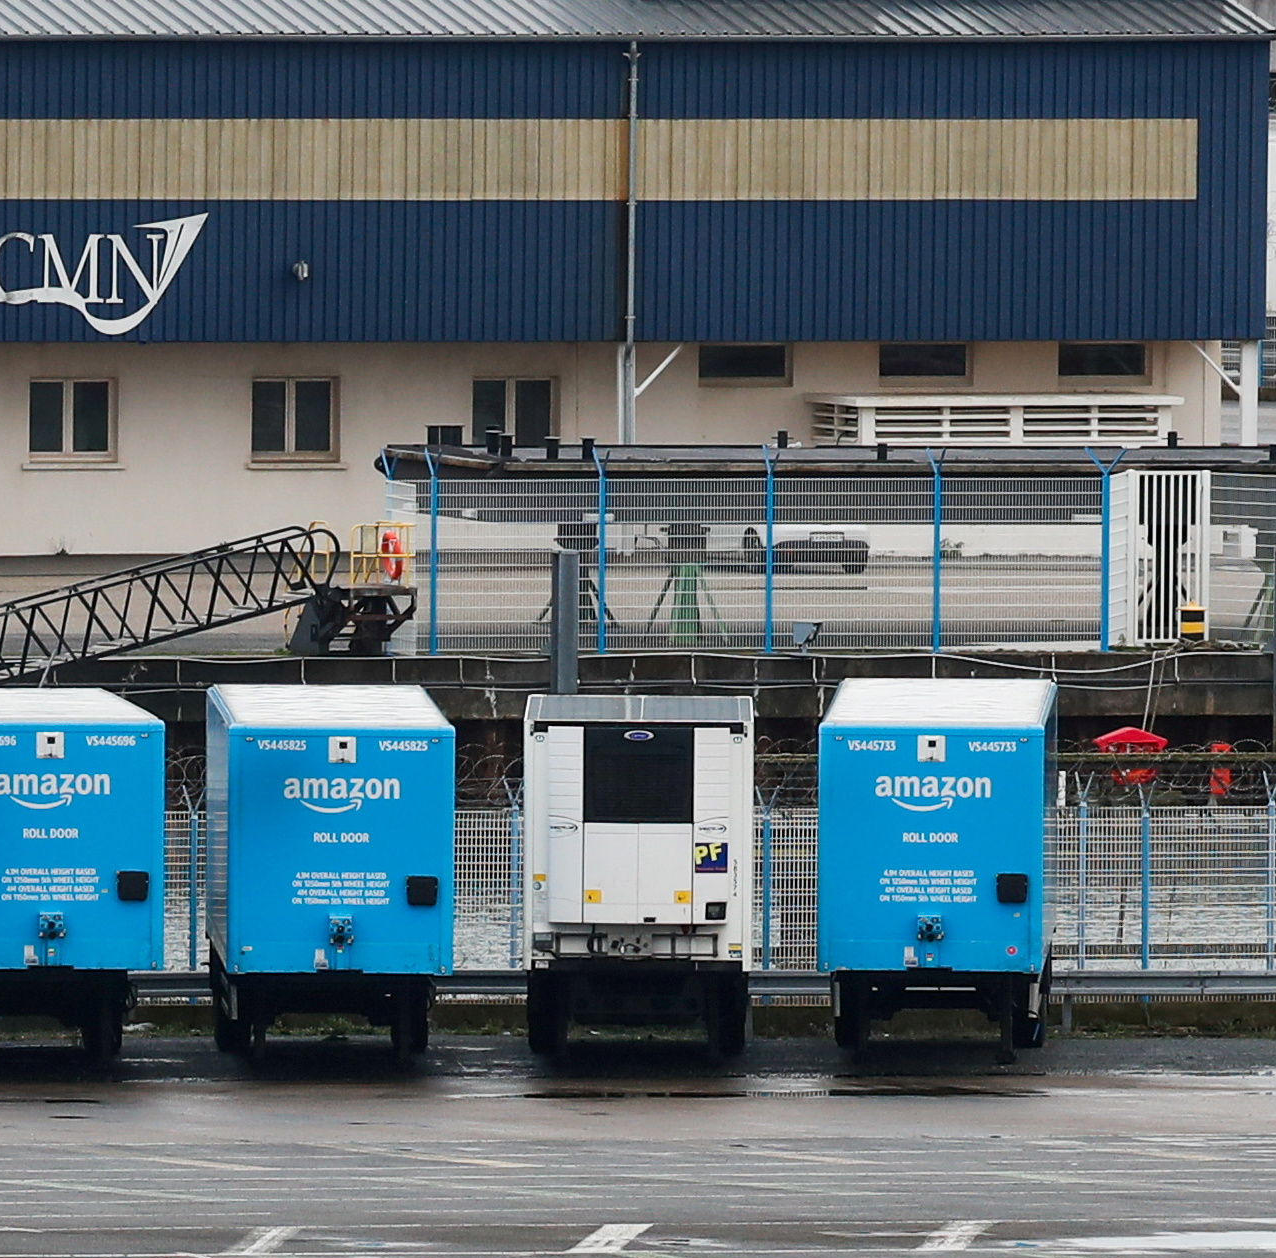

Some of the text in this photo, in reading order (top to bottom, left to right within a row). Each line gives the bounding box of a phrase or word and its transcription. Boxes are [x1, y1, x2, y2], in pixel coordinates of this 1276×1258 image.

[86, 735, 136, 747] VS445696
[257, 739, 307, 751] VS445825
[379, 740, 428, 752] VS445825
[847, 739, 897, 751] VS445733
[968, 741, 1017, 752] VS445733
[283, 777, 401, 803] amazon
[875, 775, 992, 801] amazon
[22, 828, 79, 839] ROLL DOOR
[313, 832, 369, 843] ROLL DOOR
[902, 832, 959, 843] ROLL DOOR
[694, 843, 722, 865] PF
